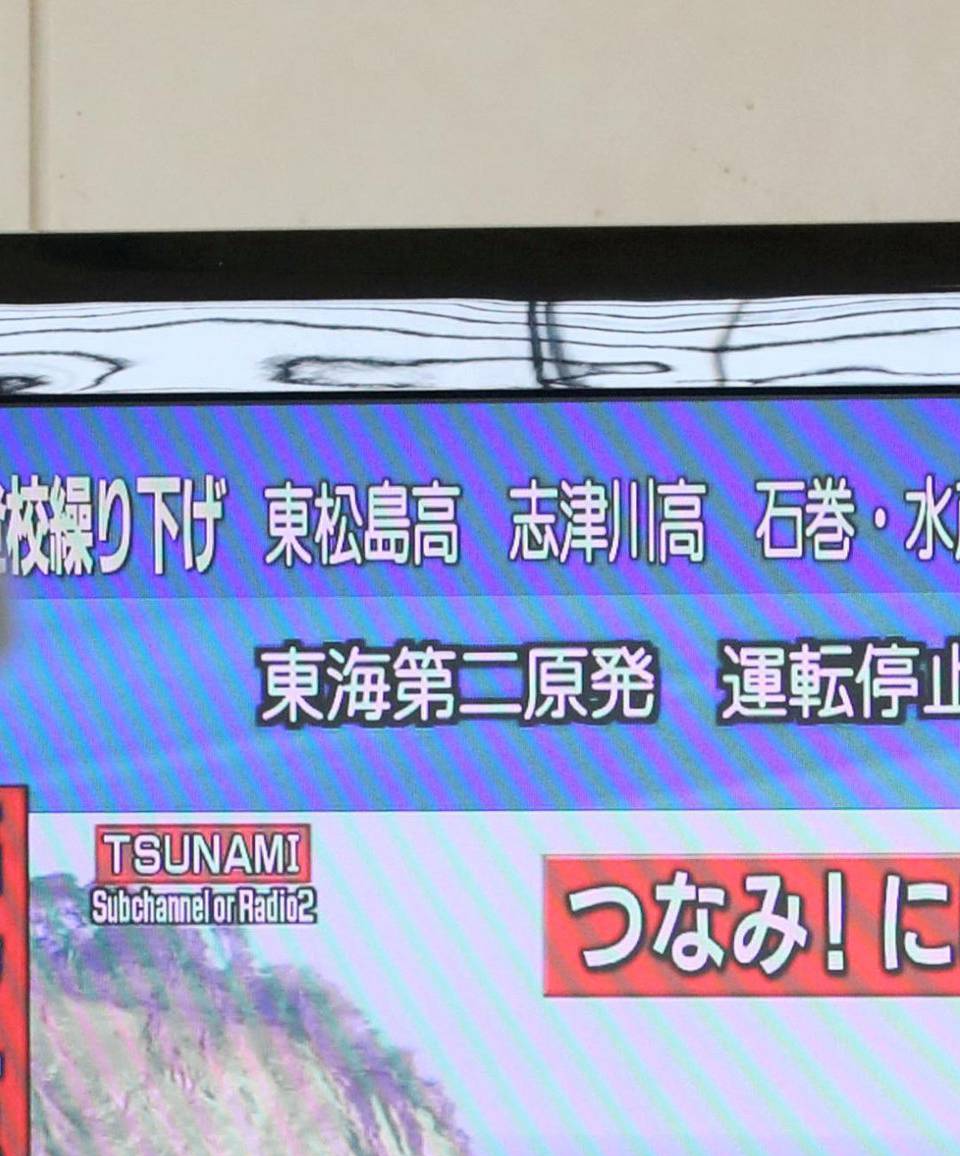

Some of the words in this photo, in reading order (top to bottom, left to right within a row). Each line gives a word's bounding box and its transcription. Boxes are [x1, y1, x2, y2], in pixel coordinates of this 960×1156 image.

[0, 474, 228, 577] 校繰り下げ
[264, 480, 461, 567] 東松島高
[509, 477, 707, 565] 志津川高
[260, 644, 656, 723] 東海第二原発
[102, 833, 301, 875] TSUNAMI
[91, 887, 210, 924] Subchannel
[213, 892, 236, 924] or
